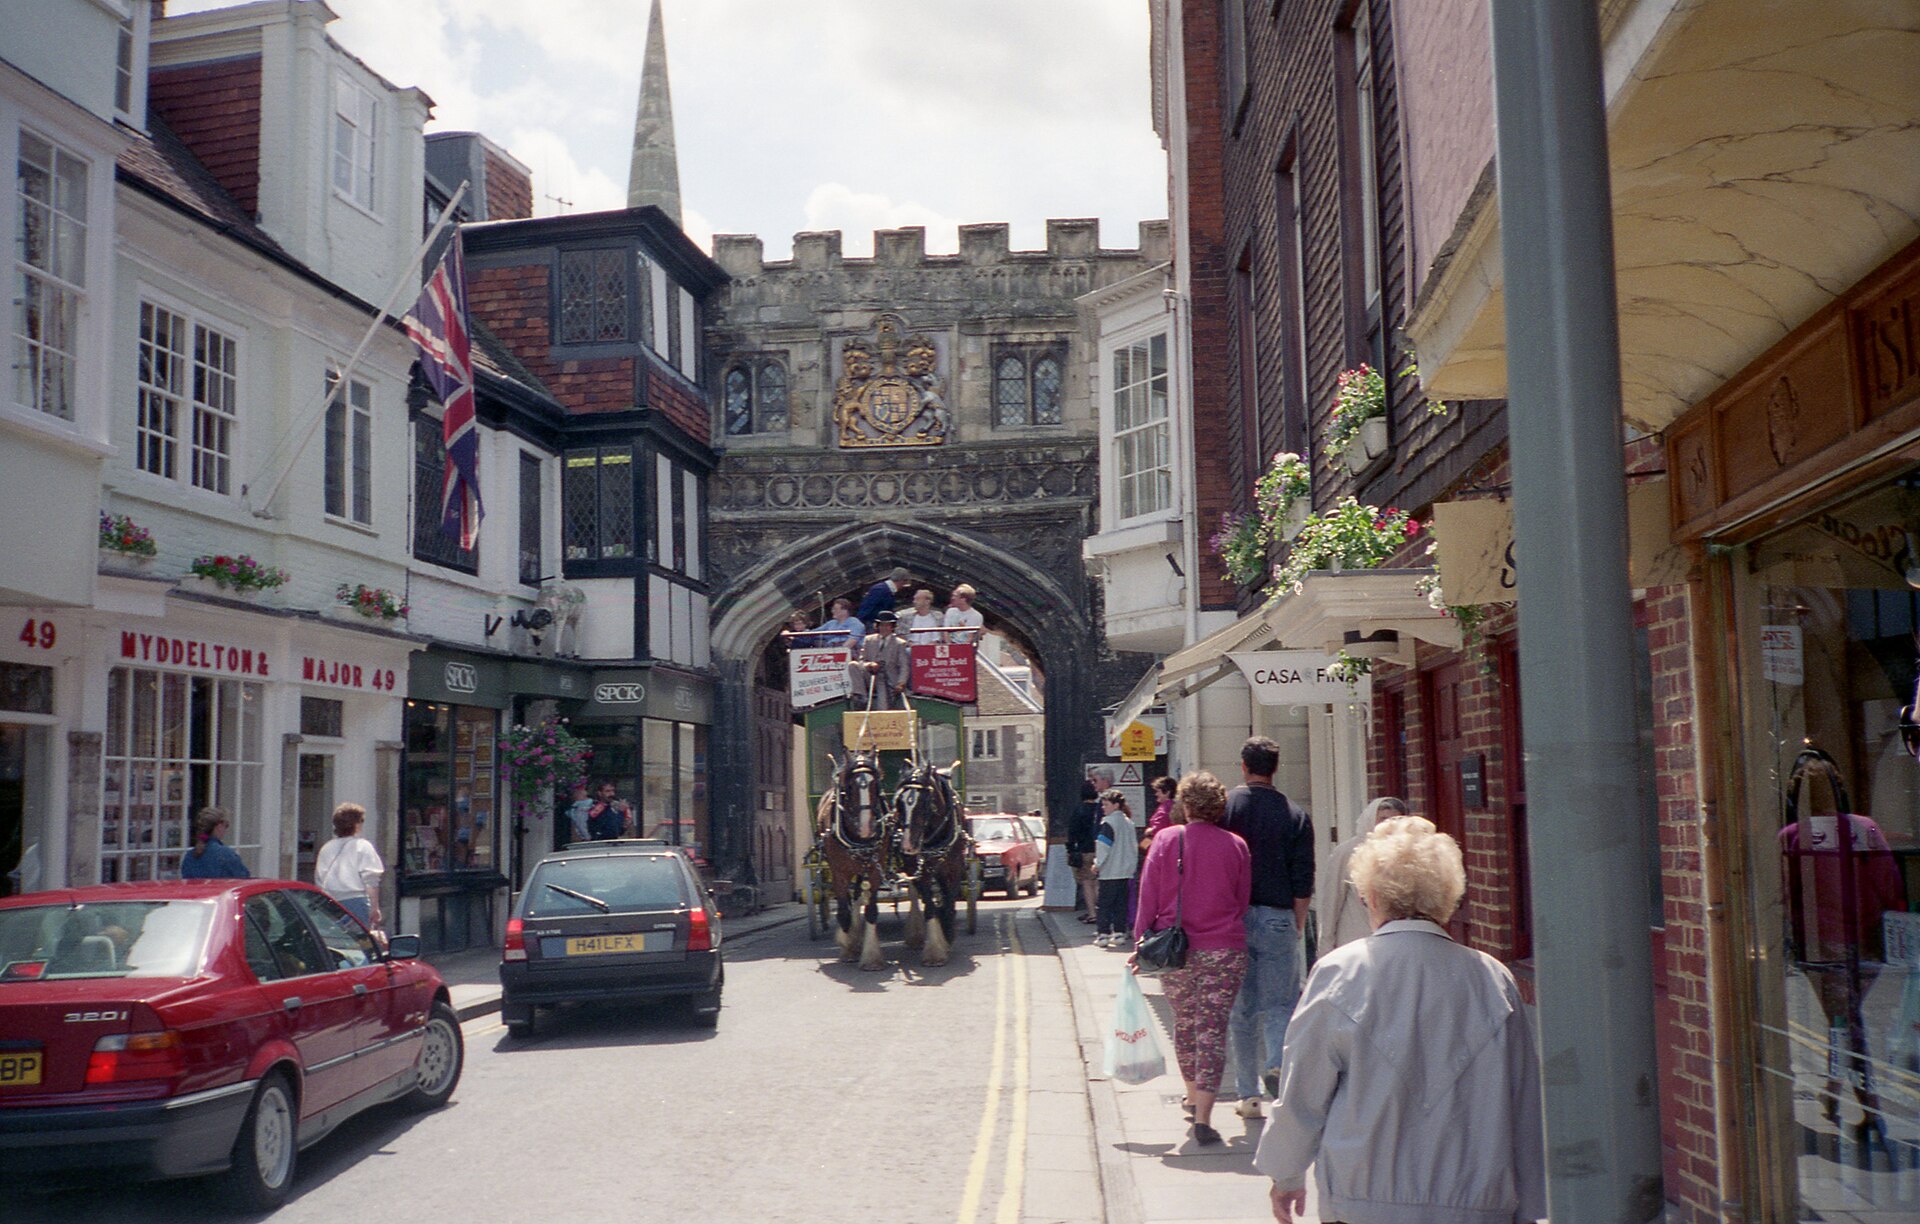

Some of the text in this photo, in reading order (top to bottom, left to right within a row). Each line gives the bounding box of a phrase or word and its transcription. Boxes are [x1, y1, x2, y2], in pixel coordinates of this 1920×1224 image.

[19, 618, 56, 650] 49
[121, 630, 269, 676] MYDDELTON &
[303, 656, 396, 691] MAJOR 49
[447, 665, 476, 689] SPCK
[1254, 669, 1303, 684] CASA
[598, 686, 640, 700] SPCK
